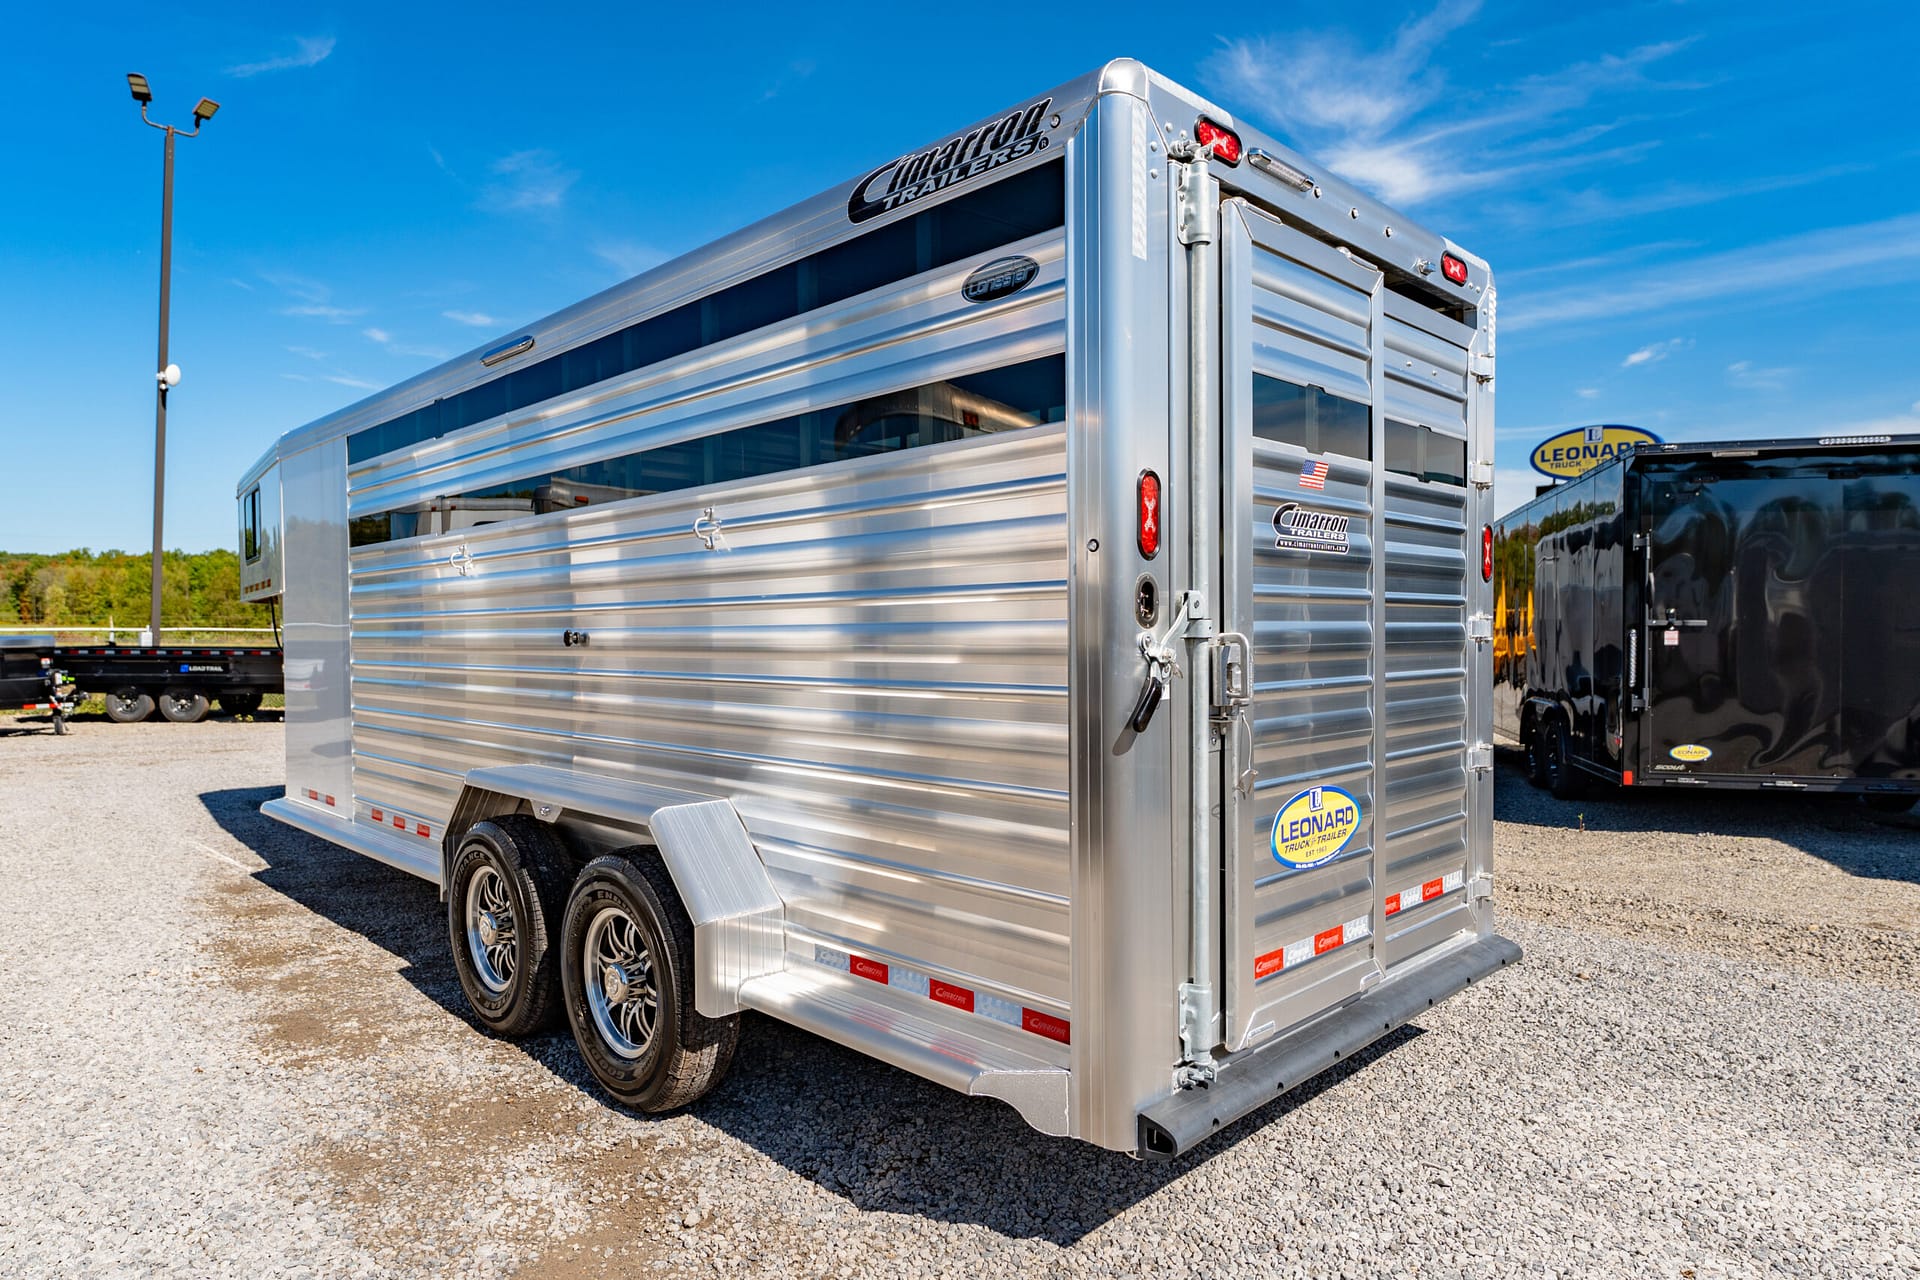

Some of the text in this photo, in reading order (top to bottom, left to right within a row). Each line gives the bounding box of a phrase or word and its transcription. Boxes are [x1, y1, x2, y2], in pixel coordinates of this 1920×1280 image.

[847, 97, 1053, 224] Cimarron
[883, 138, 1034, 210] TRAILERS
[1549, 461, 1582, 469] TRUCK
[1273, 503, 1348, 537] Cimarron
[1290, 528, 1345, 541] TRAILERS
[1281, 806, 1354, 843] LEONARD
[1284, 840, 1310, 854] TRUCK
[1317, 828, 1347, 845] TRAILER
